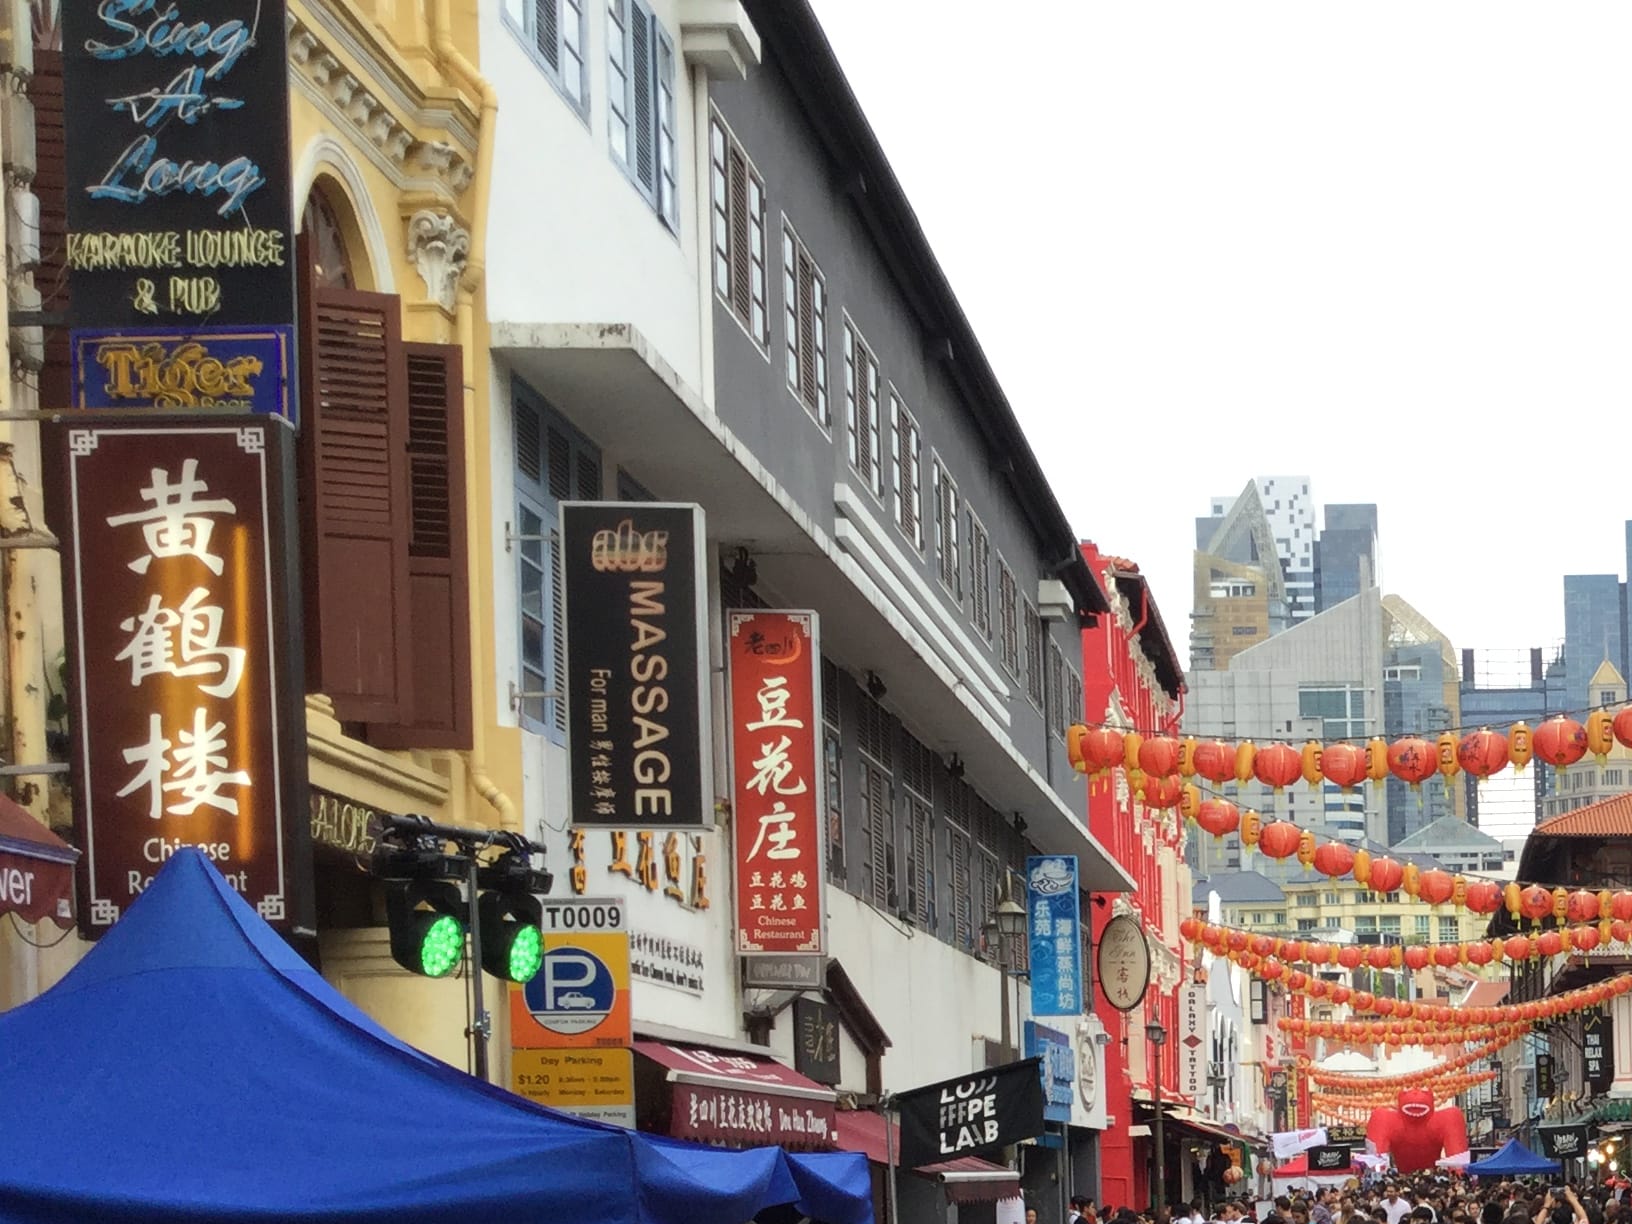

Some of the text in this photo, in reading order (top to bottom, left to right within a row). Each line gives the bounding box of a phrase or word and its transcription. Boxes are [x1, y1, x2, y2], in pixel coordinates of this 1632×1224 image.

[85, 0, 252, 79] Sing
[86, 135, 266, 217] Long
[67, 228, 285, 271] KARAOKE LOUNGE
[134, 276, 221, 314] & PUB
[97, 342, 263, 407] Tiger
[106, 459, 252, 819] 黄鹤楼
[590, 669, 611, 732] For man
[630, 580, 672, 815] MASSAGE
[746, 678, 807, 862] 豆花庄
[144, 838, 230, 863] Chiese
[546, 906, 621, 928] T0009
[750, 894, 807, 911] 豆花鱼
[758, 915, 796, 927] Chinese
[754, 928, 805, 940] Restaurant
[1188, 991, 1196, 1033] GALAXY
[540, 1056, 603, 1067] Day Parking
[1585, 1047, 1602, 1059] RELAX
[1588, 1060, 1600, 1072] SPA
[518, 1074, 550, 1085] $1.20
